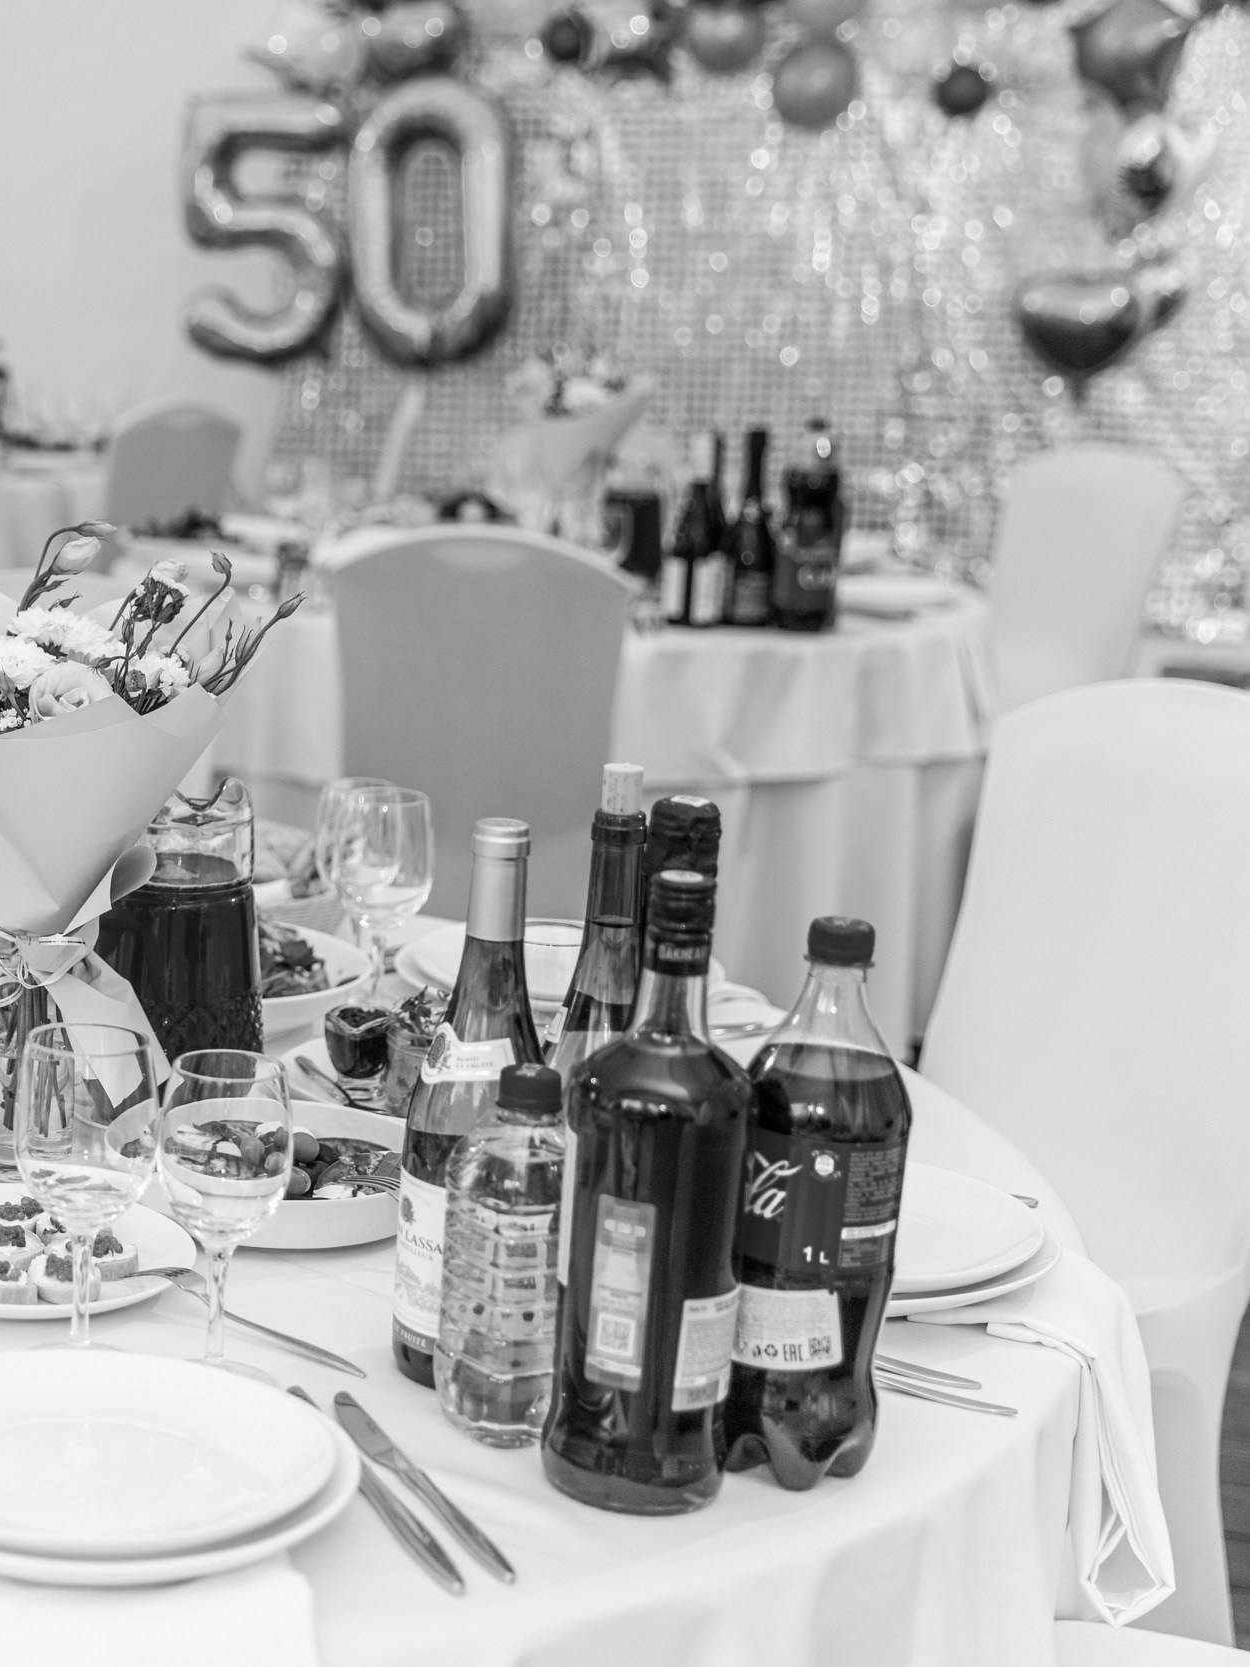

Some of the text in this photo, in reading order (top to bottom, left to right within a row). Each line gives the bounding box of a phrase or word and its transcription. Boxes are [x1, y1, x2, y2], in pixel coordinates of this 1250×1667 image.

[184, 80, 514, 370] 50
[803, 1245, 813, 1263] 1
[818, 1251, 830, 1265] L
